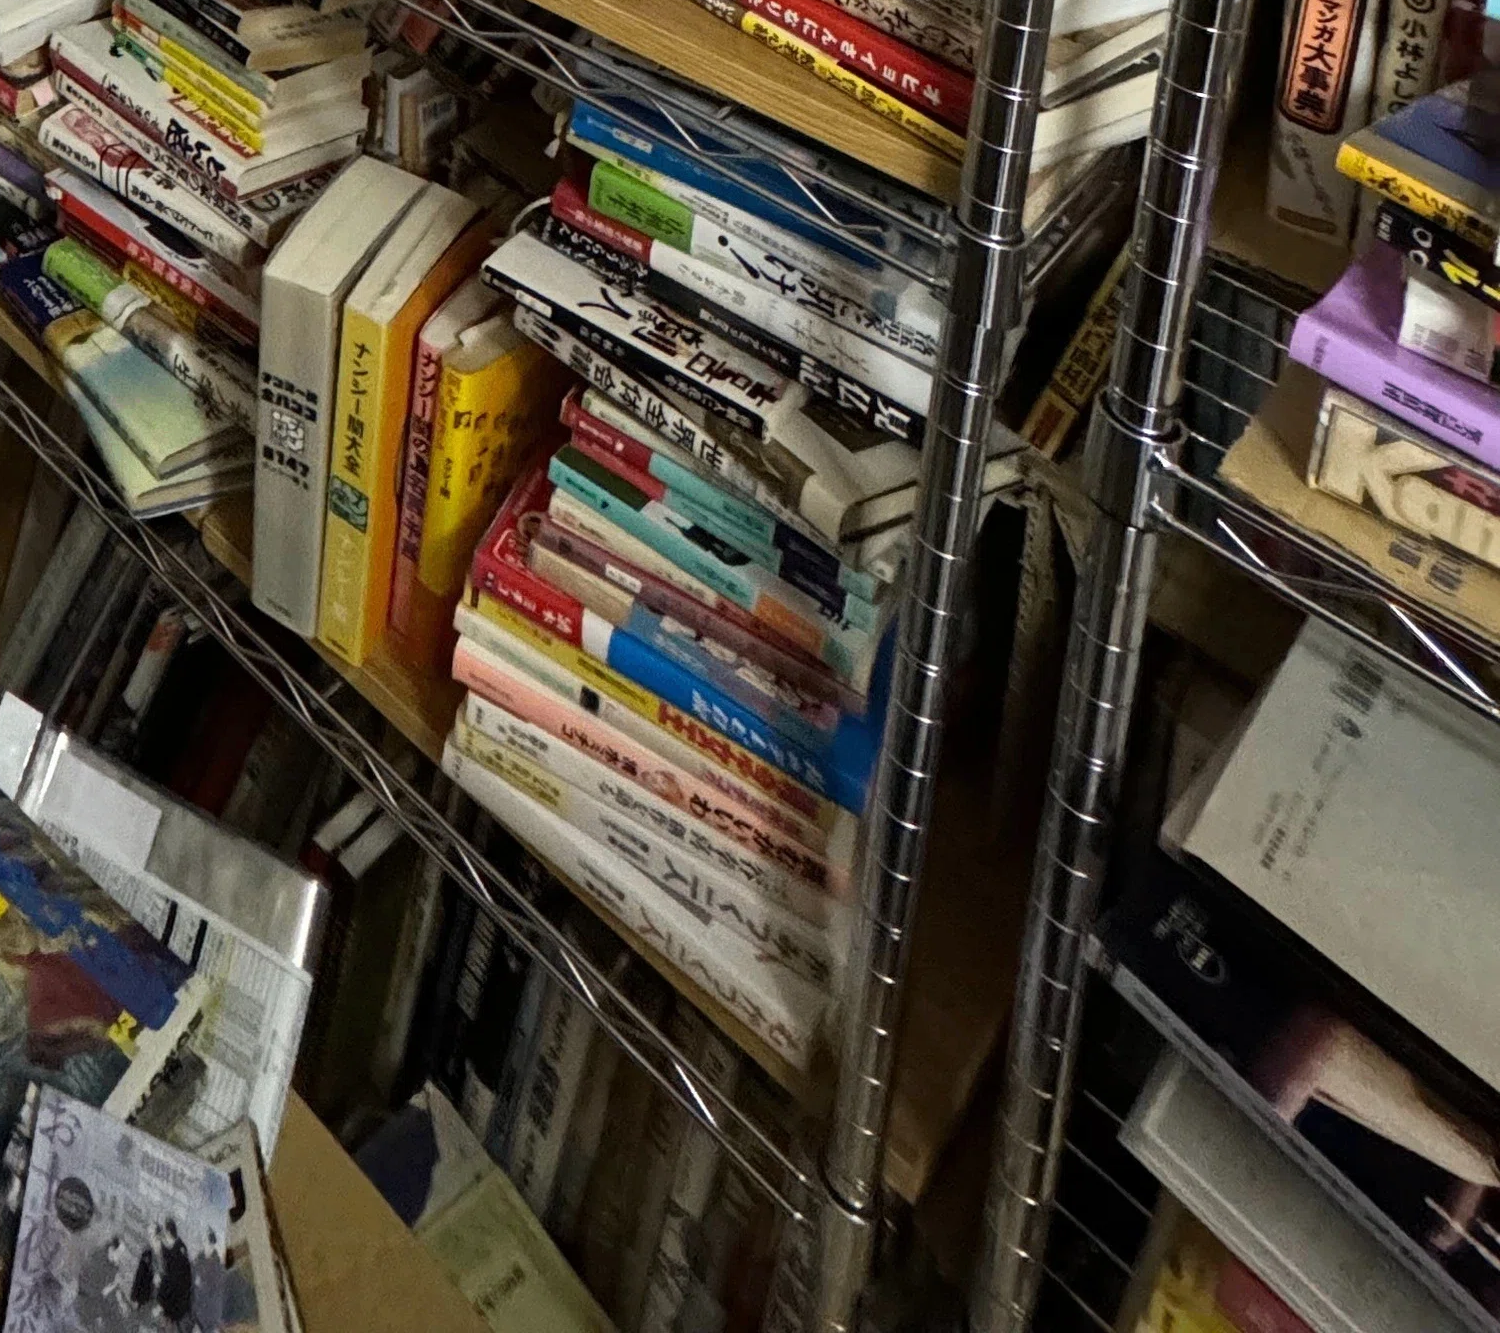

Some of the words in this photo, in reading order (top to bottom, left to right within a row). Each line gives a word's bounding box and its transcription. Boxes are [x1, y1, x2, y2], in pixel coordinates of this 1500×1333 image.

[341, 338, 371, 477] ナンシー関大全
[799, 352, 911, 438] 見仏記
